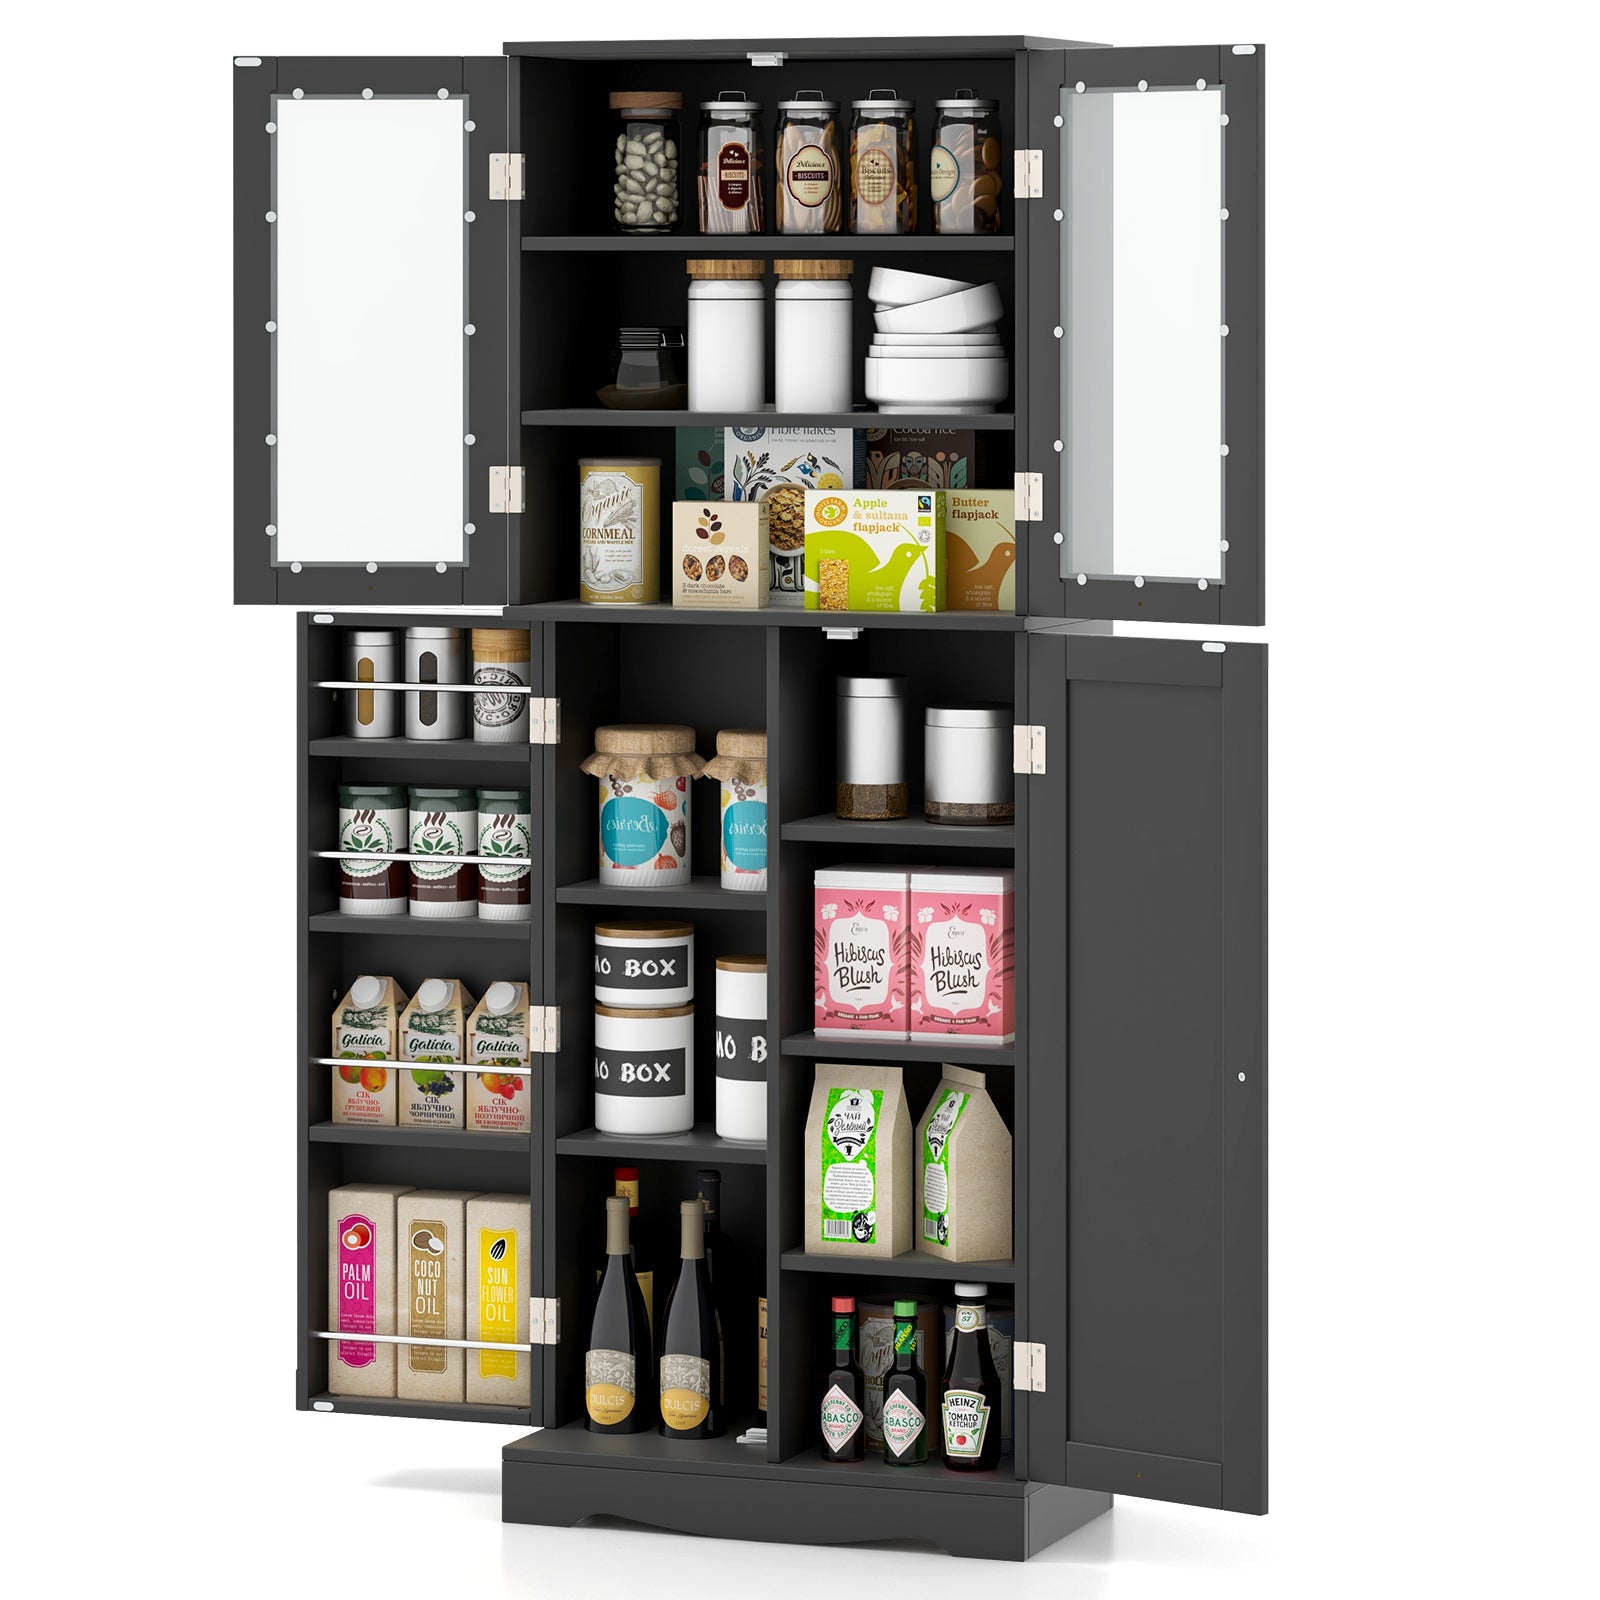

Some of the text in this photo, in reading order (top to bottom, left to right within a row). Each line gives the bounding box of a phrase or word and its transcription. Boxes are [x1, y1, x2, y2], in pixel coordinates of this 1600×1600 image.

[797, 172, 825, 180] BISCUITS
[582, 486, 632, 524] Organic
[853, 498, 888, 510] Apple
[952, 497, 989, 507] Butter
[853, 510, 908, 520] & sultana
[952, 510, 999, 521] flapjack
[583, 528, 635, 539] CORNMEAL
[853, 522, 900, 534] flapjack
[834, 942, 885, 966] Hibiscus
[930, 946, 982, 970] Hibiscus
[624, 958, 676, 977] BOX
[834, 964, 883, 989] Blush
[930, 968, 980, 993] Blush
[342, 1034, 385, 1048] Galicia
[409, 1038, 455, 1052] Galicia
[476, 1040, 523, 1054] Galicia
[620, 1062, 671, 1083] BOX
[844, 1111, 861, 1121] ЧАЙ
[342, 1263, 371, 1281] PALM
[414, 1259, 441, 1278] COCO
[487, 1266, 508, 1285] SUN
[344, 1281, 369, 1300] OIL
[417, 1278, 438, 1296] NUT
[482, 1284, 514, 1304] FLOWER
[415, 1296, 440, 1315] OIL
[485, 1303, 510, 1322] OIL
[865, 1375, 884, 1386] HOLE
[590, 1392, 625, 1406] DULCIS
[664, 1398, 700, 1411] DULCIS
[949, 1397, 976, 1409] HEINZ
[821, 1412, 859, 1423] ABASCO
[884, 1416, 921, 1427] ABASCO
[948, 1411, 979, 1423] TOMATO
[949, 1420, 977, 1429] KETCHUP
